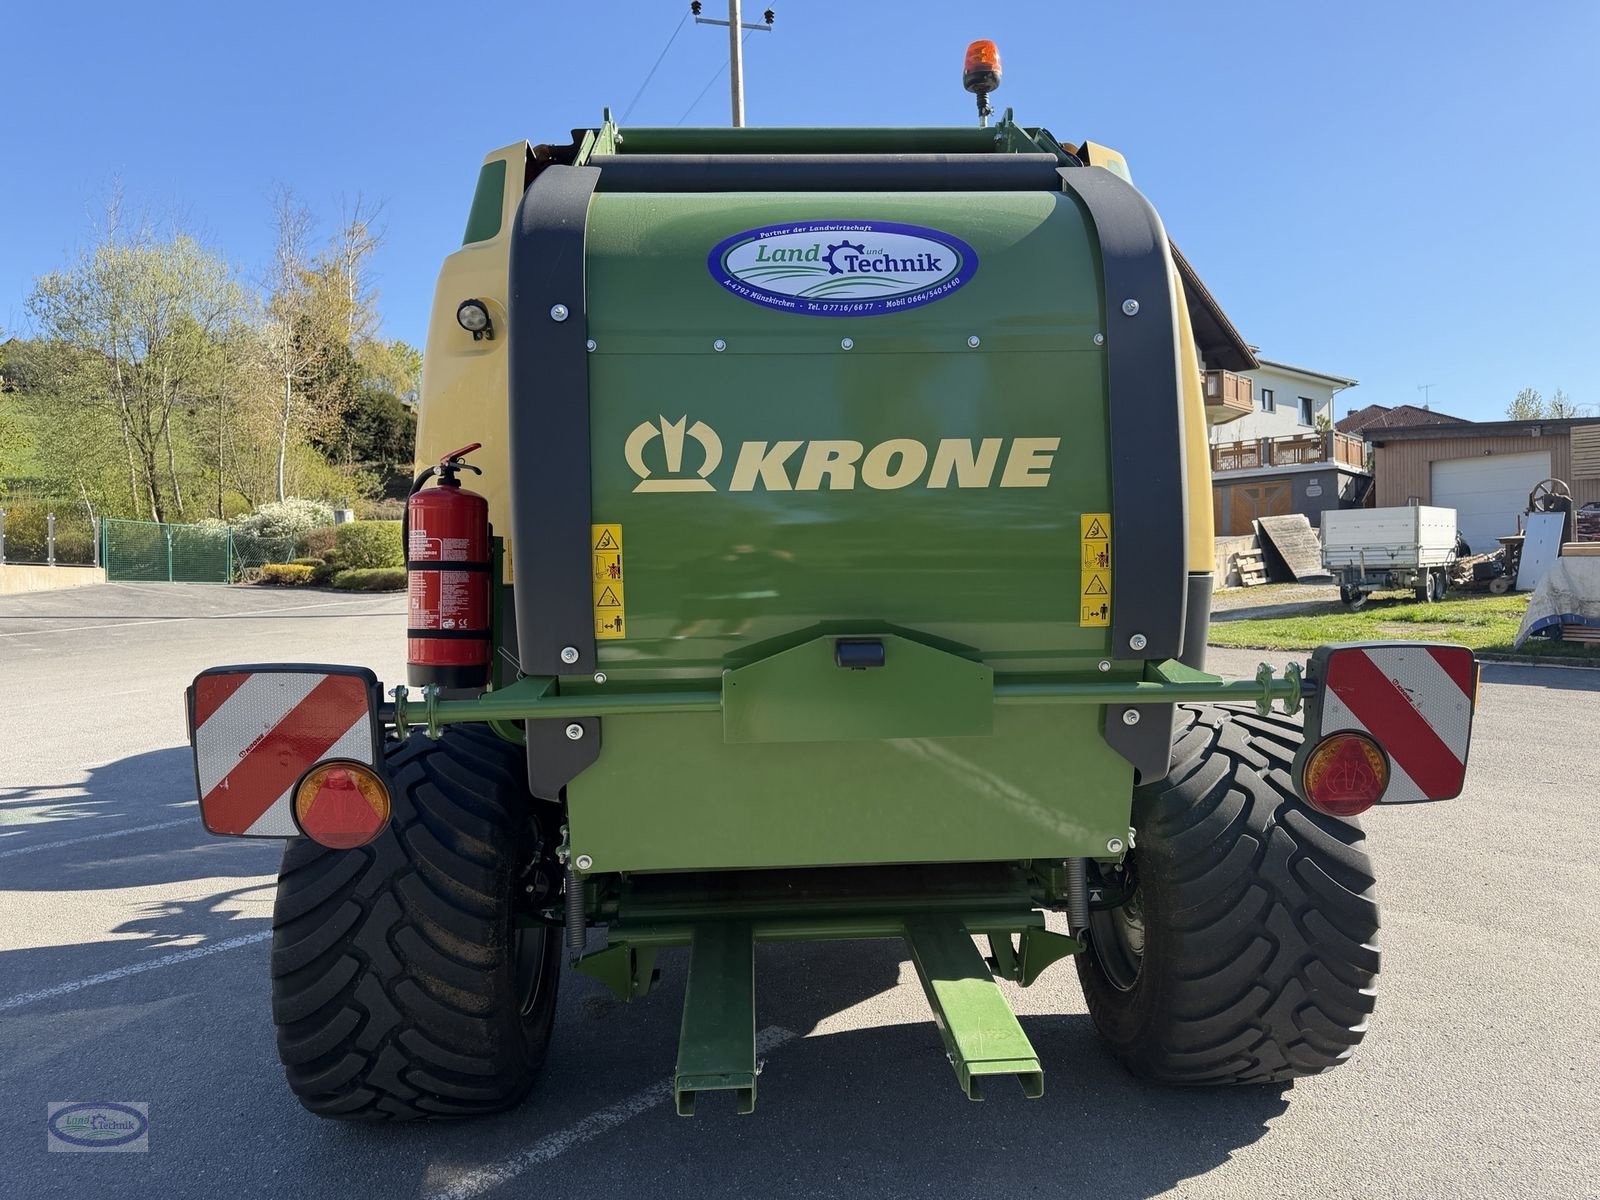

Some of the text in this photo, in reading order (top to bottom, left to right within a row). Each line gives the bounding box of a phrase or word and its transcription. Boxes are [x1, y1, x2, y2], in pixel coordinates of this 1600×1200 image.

[760, 229, 790, 239] Partner
[755, 243, 820, 262] Land
[844, 253, 942, 273] Technik
[724, 280, 750, 296] A-4792
[750, 291, 795, 308] Münzkirchen
[808, 303, 820, 311] Tel.
[886, 298, 906, 308] Mobil
[728, 437, 1062, 492] KRONE
